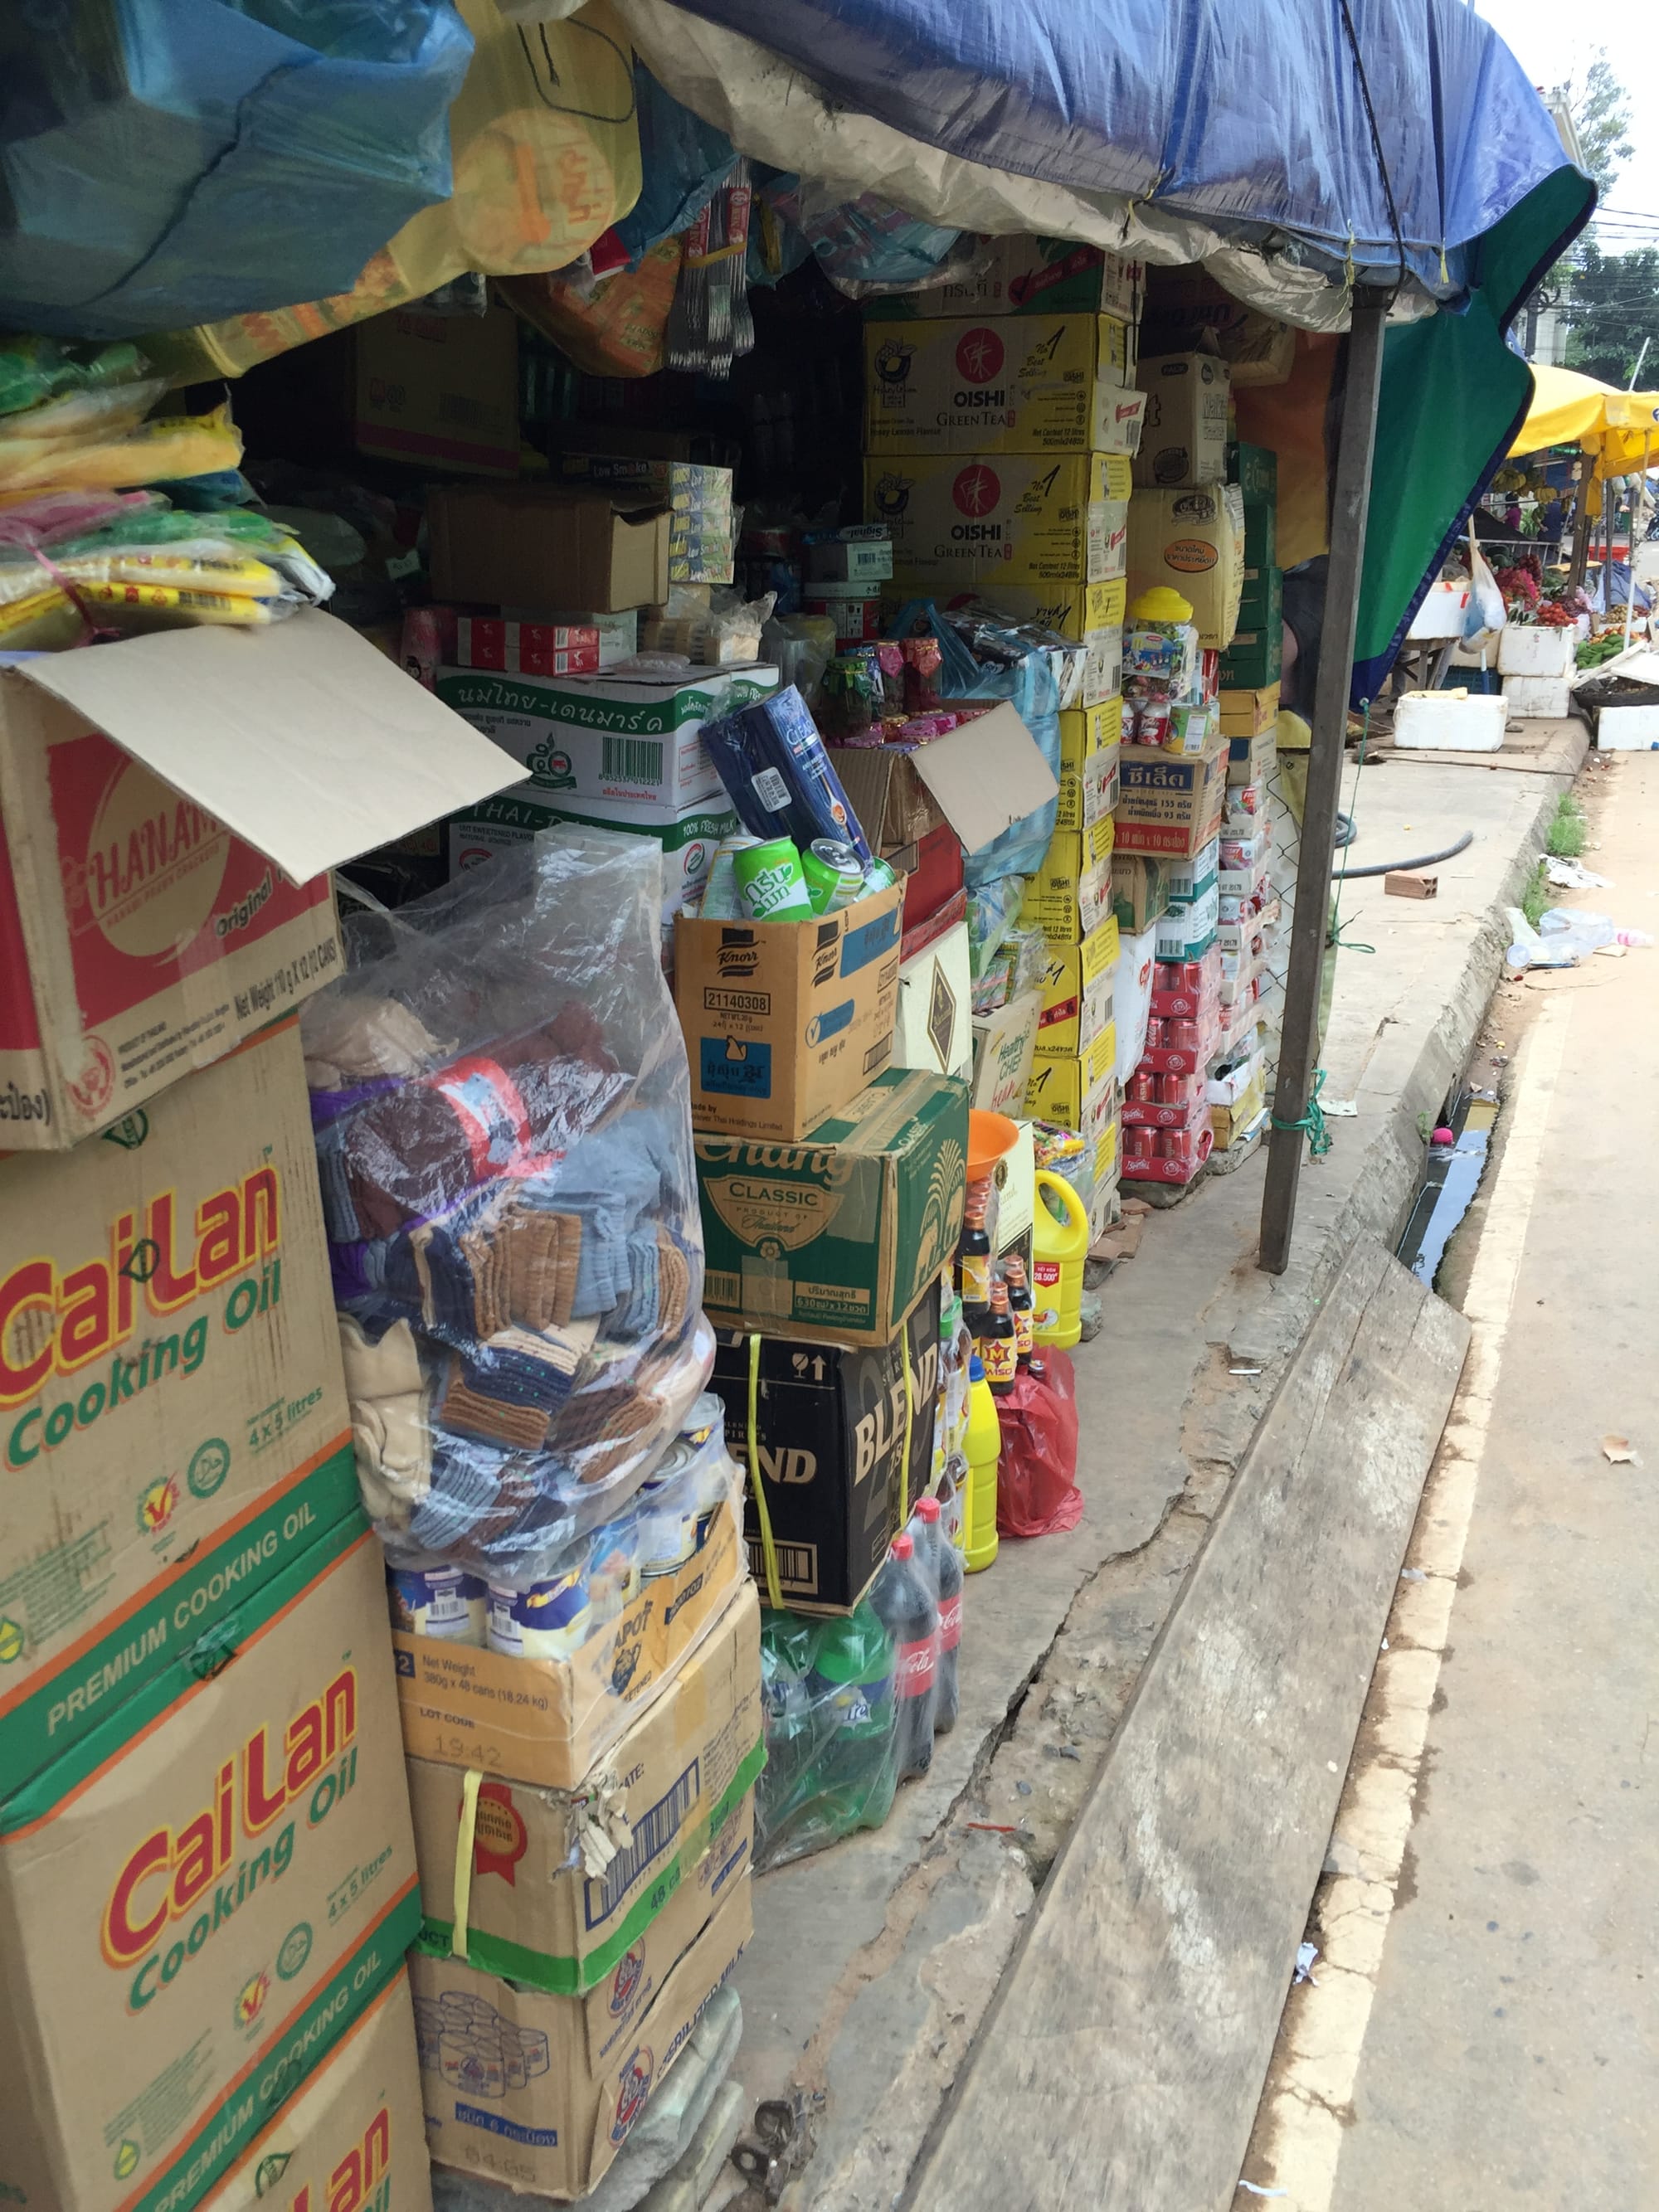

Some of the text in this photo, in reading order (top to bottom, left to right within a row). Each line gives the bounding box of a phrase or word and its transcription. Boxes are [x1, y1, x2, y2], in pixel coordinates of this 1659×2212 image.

[953, 391, 1005, 407] OISHI
[937, 411, 1008, 427] GREEN TEA
[591, 463, 611, 479] Low
[951, 524, 1002, 541] OISHI
[934, 544, 1003, 558] GREEN TEA
[1160, 799, 1175, 809] 155
[683, 823, 699, 838] 100%
[700, 819, 719, 835] FRESH
[215, 864, 274, 939] Original
[717, 950, 758, 966] Knorr
[233, 992, 251, 1021] Net
[708, 992, 767, 1011] 21140308
[1035, 1067, 1053, 1093] 1
[729, 1181, 819, 1207] CLASSIC
[736, 1206, 788, 1219] PRODUCT
[741, 1213, 802, 1234] Thailand
[0, 1164, 280, 1402] CaiLan
[7, 1261, 284, 1470] Cooking Oil
[287, 1386, 323, 1422] litres
[854, 1342, 938, 1487] BLEND
[46, 1621, 168, 1738] PREMIUM
[173, 1533, 279, 1631] COOKING
[282, 1501, 317, 1543] OIL
[422, 1654, 477, 1677] Net Weight
[472, 1686, 496, 1700] cans
[532, 1696, 549, 1713] kg)
[419, 1707, 476, 1729] LOT CODE
[103, 1664, 357, 1966] CaiLan
[129, 1821, 295, 2015] Cooking
[309, 1748, 358, 1828] Oil
[258, 1989, 349, 2101] COOKING
[353, 1951, 382, 1991] OIL
